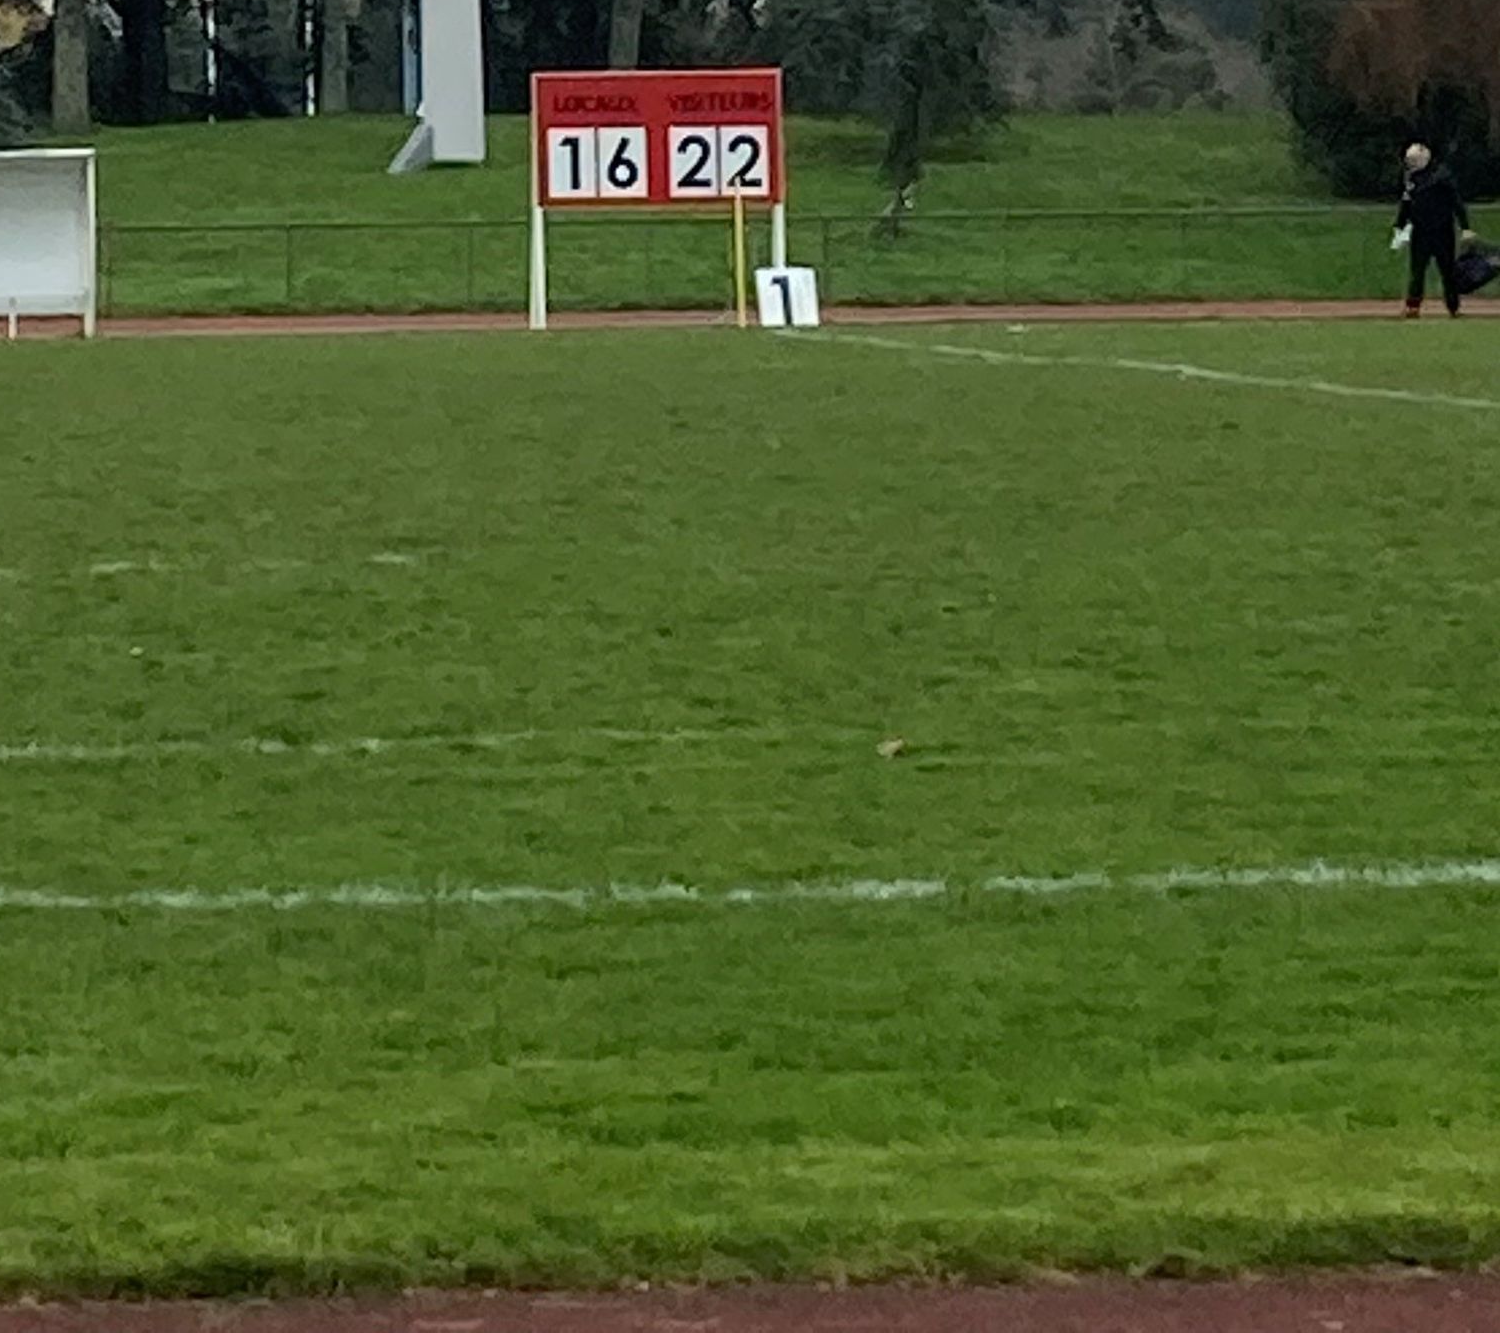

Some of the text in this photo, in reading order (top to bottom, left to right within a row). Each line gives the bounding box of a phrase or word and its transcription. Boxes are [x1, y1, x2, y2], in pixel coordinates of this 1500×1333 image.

[558, 136, 639, 190] 16
[677, 135, 763, 187] 22
[770, 276, 792, 325] 1
